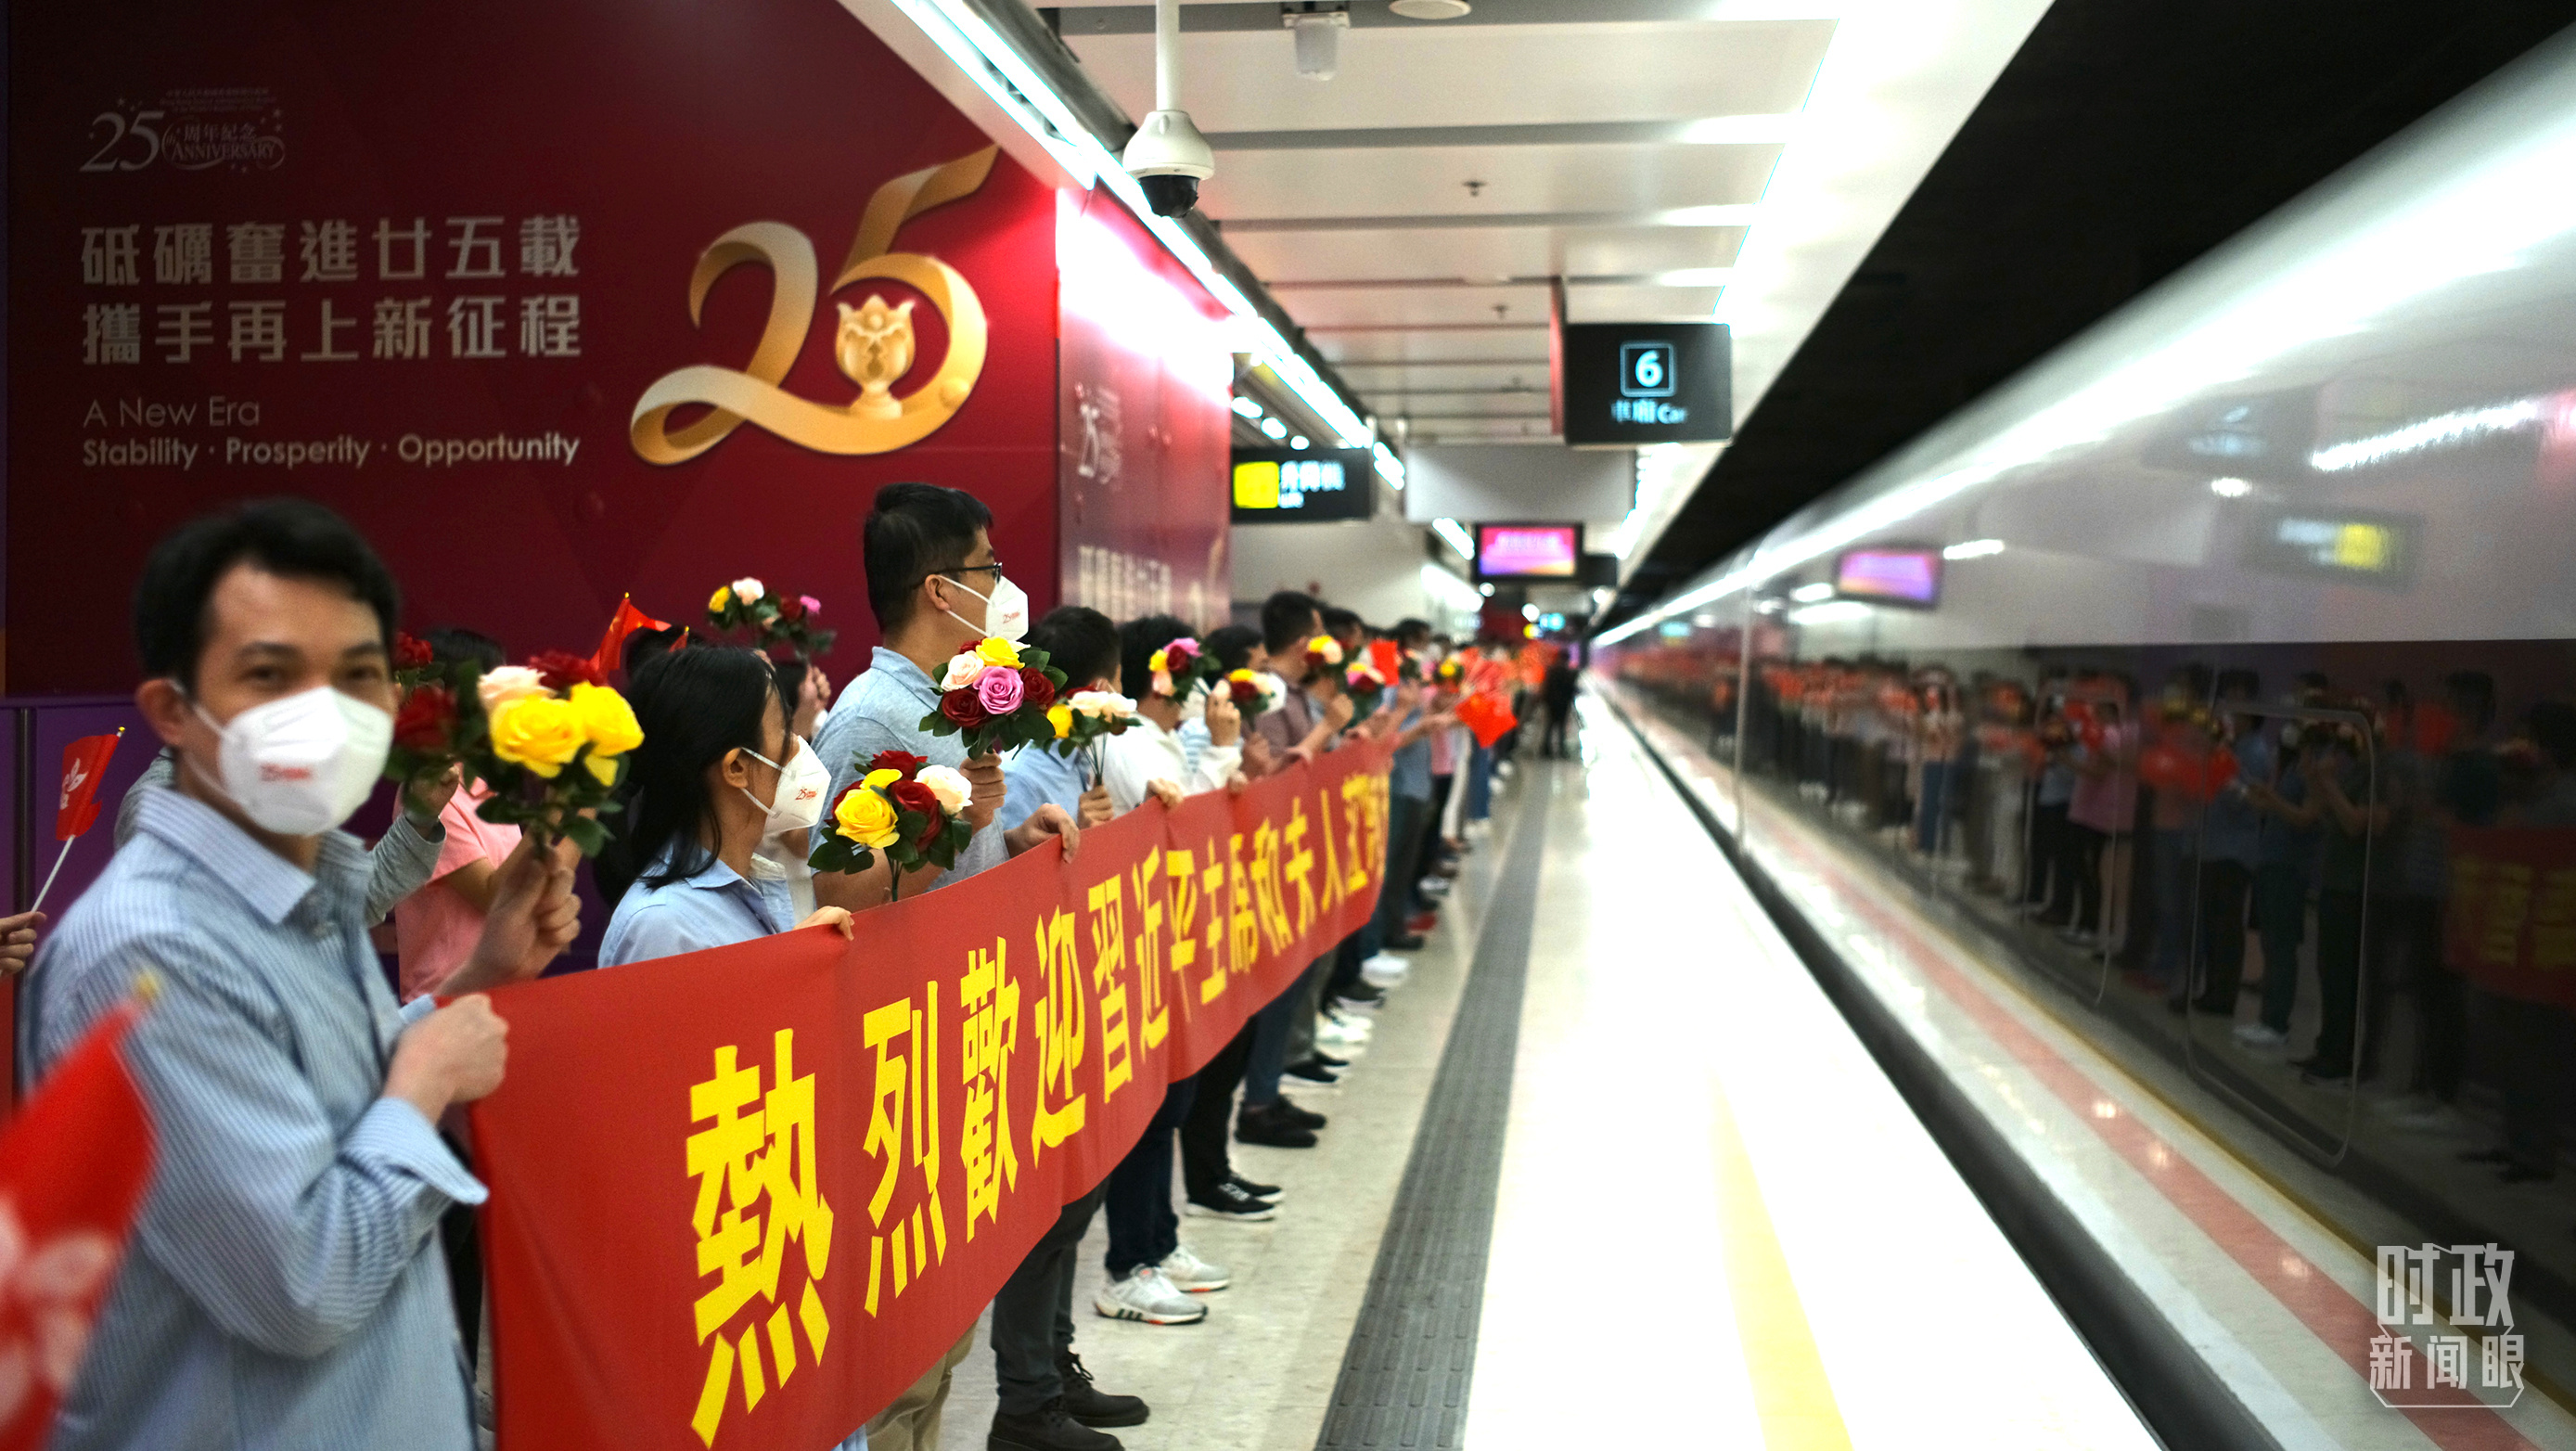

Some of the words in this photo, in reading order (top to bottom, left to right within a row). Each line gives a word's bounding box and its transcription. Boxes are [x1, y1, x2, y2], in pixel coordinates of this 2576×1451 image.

[171, 142, 276, 161] ANNIVERSARY
[83, 294, 582, 366] 攜手再上新征程
[1635, 350, 1663, 388] 6
[83, 398, 108, 429] A
[119, 396, 198, 429] New
[209, 394, 261, 428] Era
[83, 437, 199, 470] Stability
[226, 435, 371, 470] Prosperity
[398, 431, 581, 468] Opportunity
